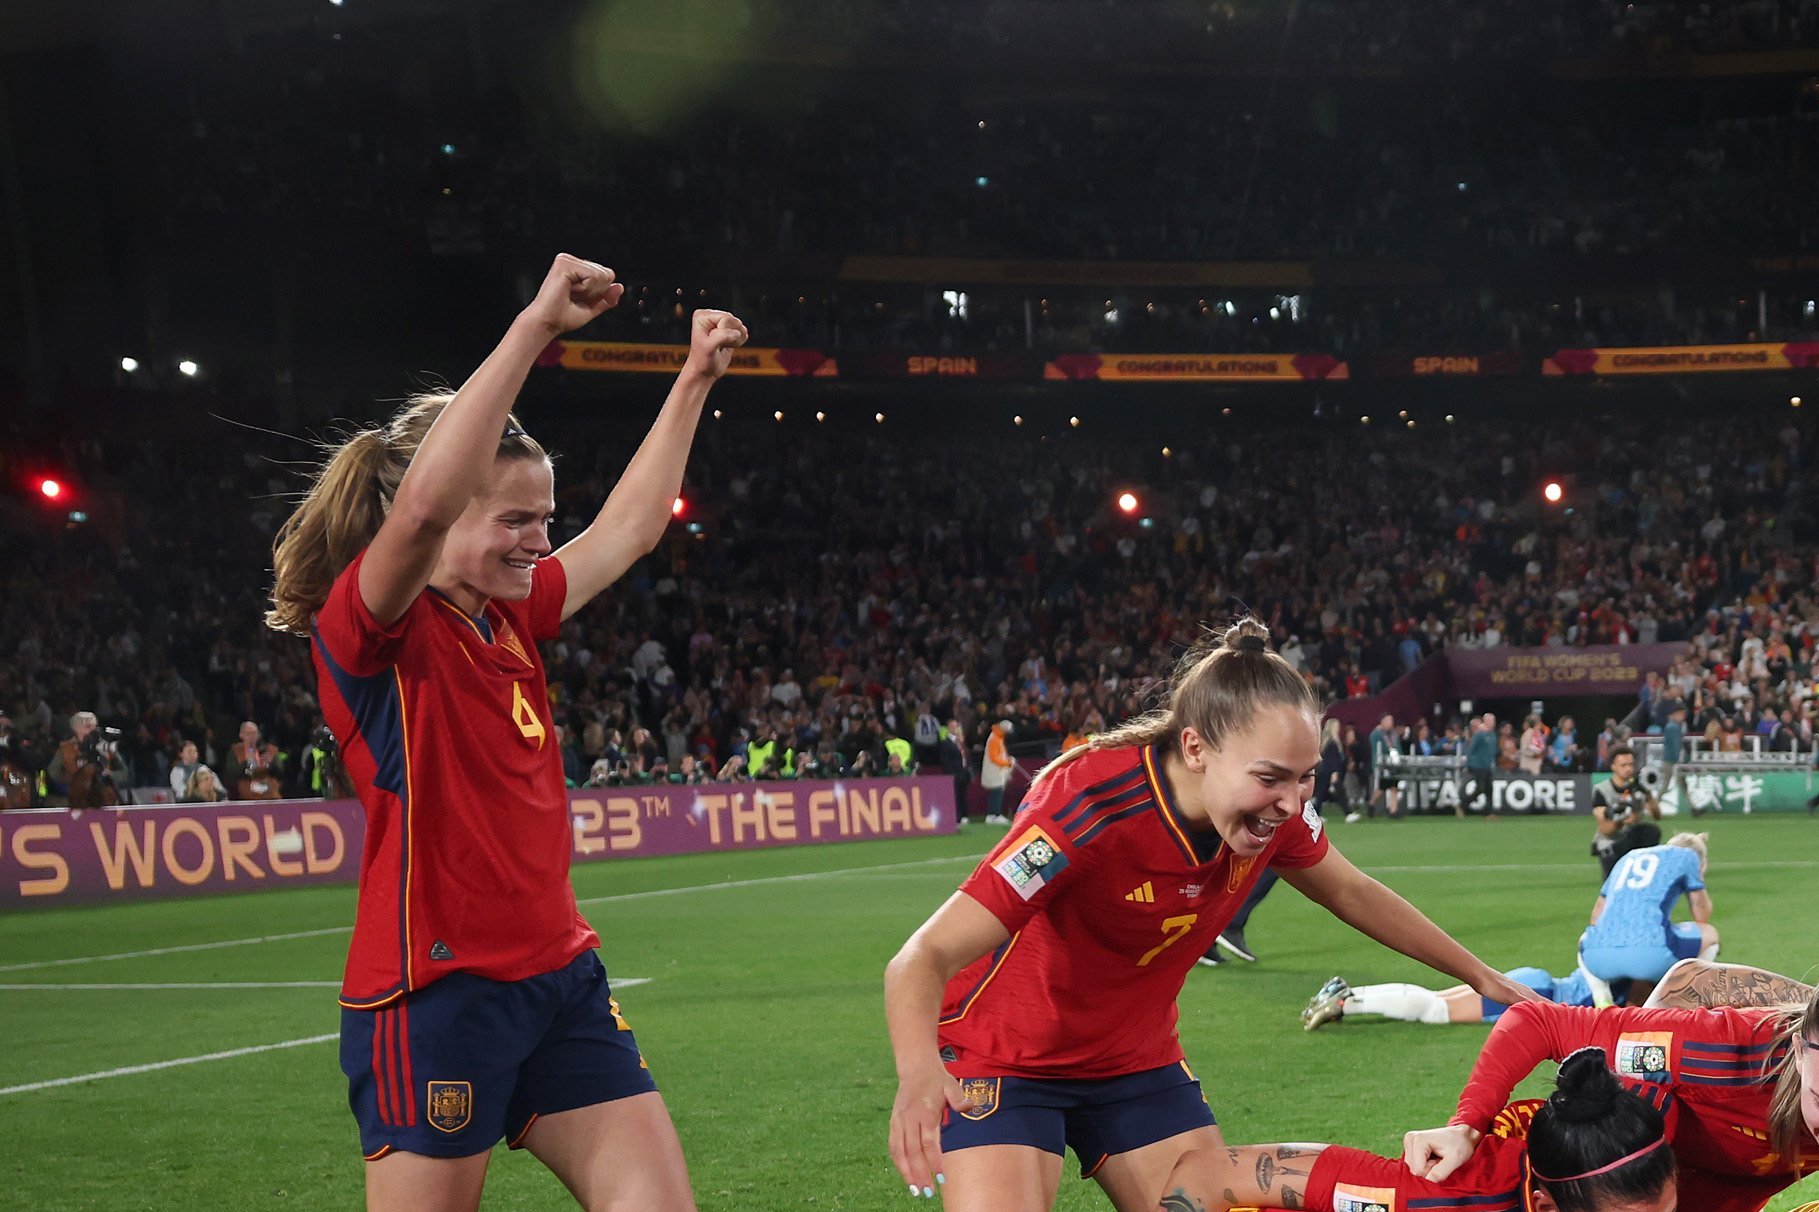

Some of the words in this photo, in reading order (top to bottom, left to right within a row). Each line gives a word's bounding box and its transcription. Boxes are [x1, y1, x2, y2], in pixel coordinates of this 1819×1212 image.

[582, 350, 760, 369] CONGRATUNS
[908, 357, 977, 374] SPAIN
[1116, 360, 1278, 374] CONGRATULATIONS
[1413, 357, 1479, 374] SPAIN
[1612, 352, 1768, 368] CONGRATULATIONS
[1491, 669, 1550, 682] WORLD
[1553, 668, 1586, 681] CUP
[512, 681, 545, 752] 4
[1684, 774, 1764, 813] 蒙牛
[699, 792, 797, 844] THE
[809, 786, 937, 838] FINAL
[90, 812, 345, 890] WORLD
[1615, 853, 1660, 890] 19
[1136, 914, 1198, 966] 7
